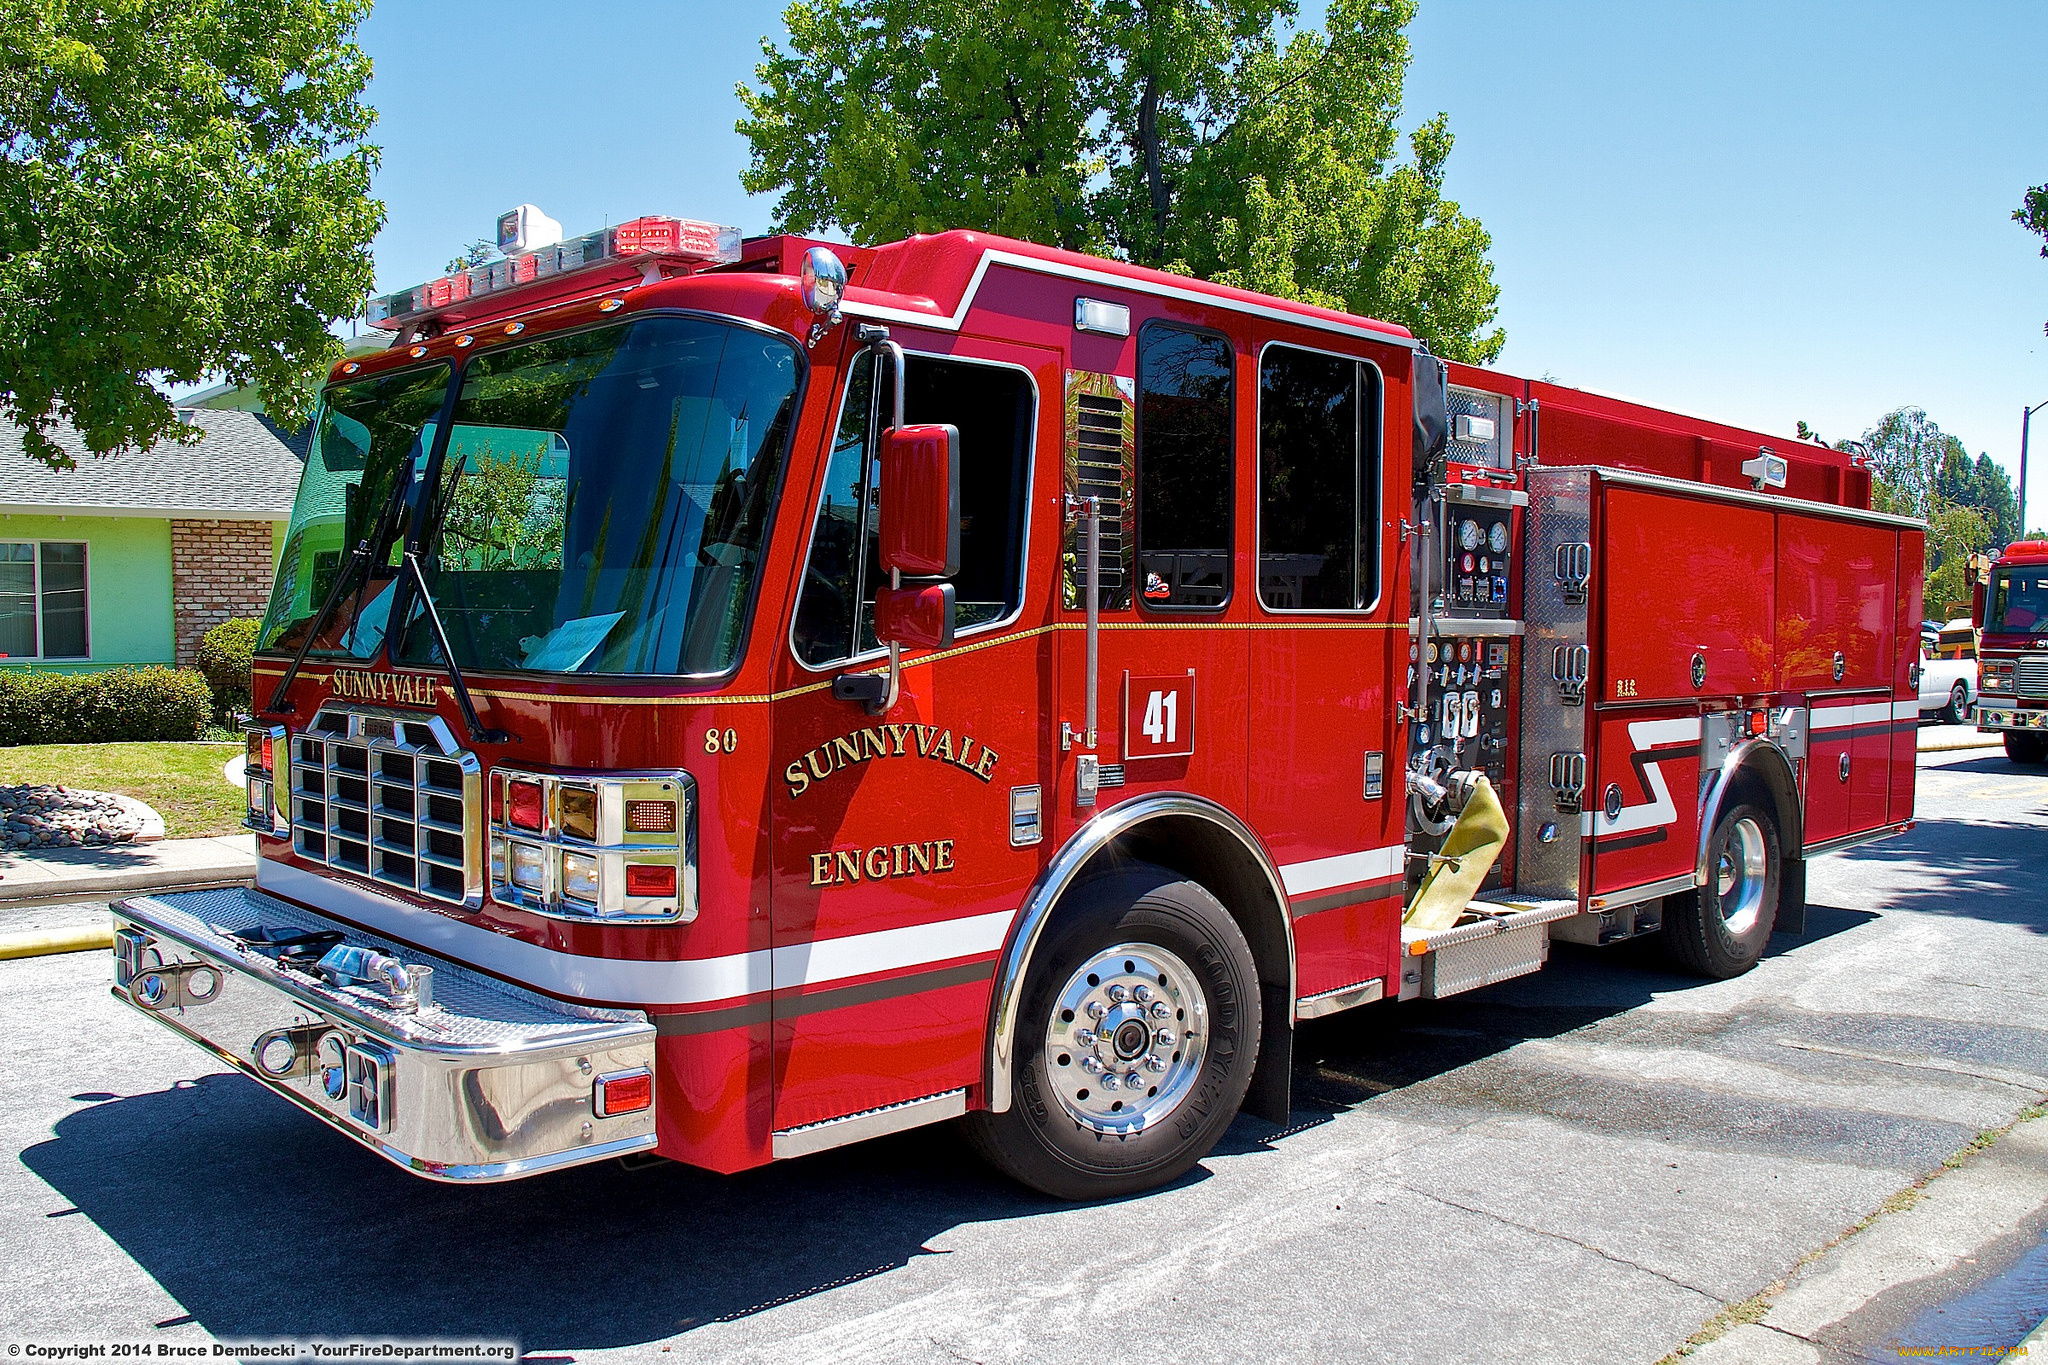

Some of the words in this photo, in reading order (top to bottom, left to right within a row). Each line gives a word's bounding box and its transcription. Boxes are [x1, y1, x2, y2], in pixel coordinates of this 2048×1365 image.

[2037, 639, 2048, 648] S
[333, 668, 438, 705] SUNNYVALE
[704, 727, 738, 754] 80
[1142, 690, 1178, 744] 41
[785, 723, 1000, 798] SUNNYVALE
[810, 839, 956, 886] ENGINE
[1175, 942, 1237, 1140] GOODYEAR
